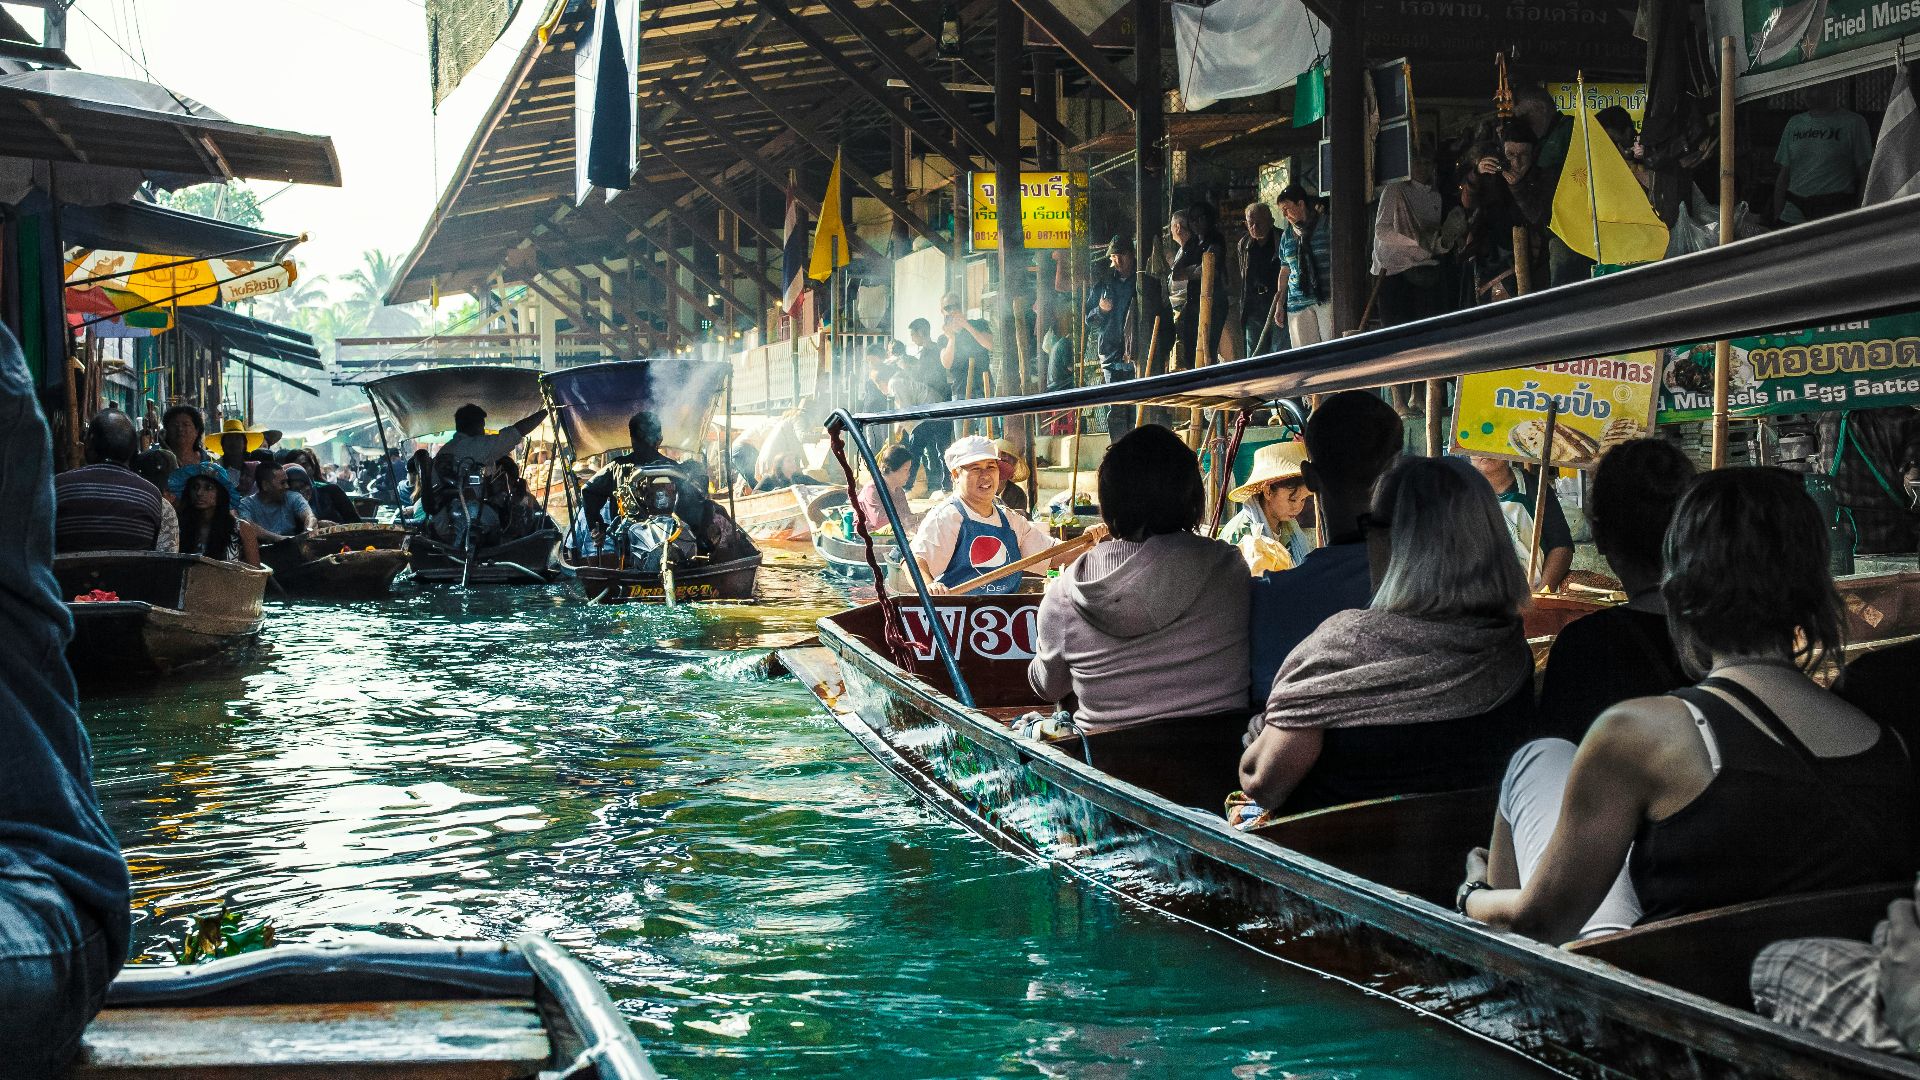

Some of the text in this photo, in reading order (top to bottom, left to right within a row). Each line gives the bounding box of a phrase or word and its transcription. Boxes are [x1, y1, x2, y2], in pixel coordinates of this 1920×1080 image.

[1824, 0, 1920, 41] Fried Muss
[1792, 128, 1827, 142] Hurley
[1496, 382, 1611, 419] กล้วยปิ้ง
[1674, 388, 1769, 410] Musels
[1776, 387, 1796, 402] in
[1804, 383, 1846, 402] Egg
[1853, 379, 1920, 396] Batte
